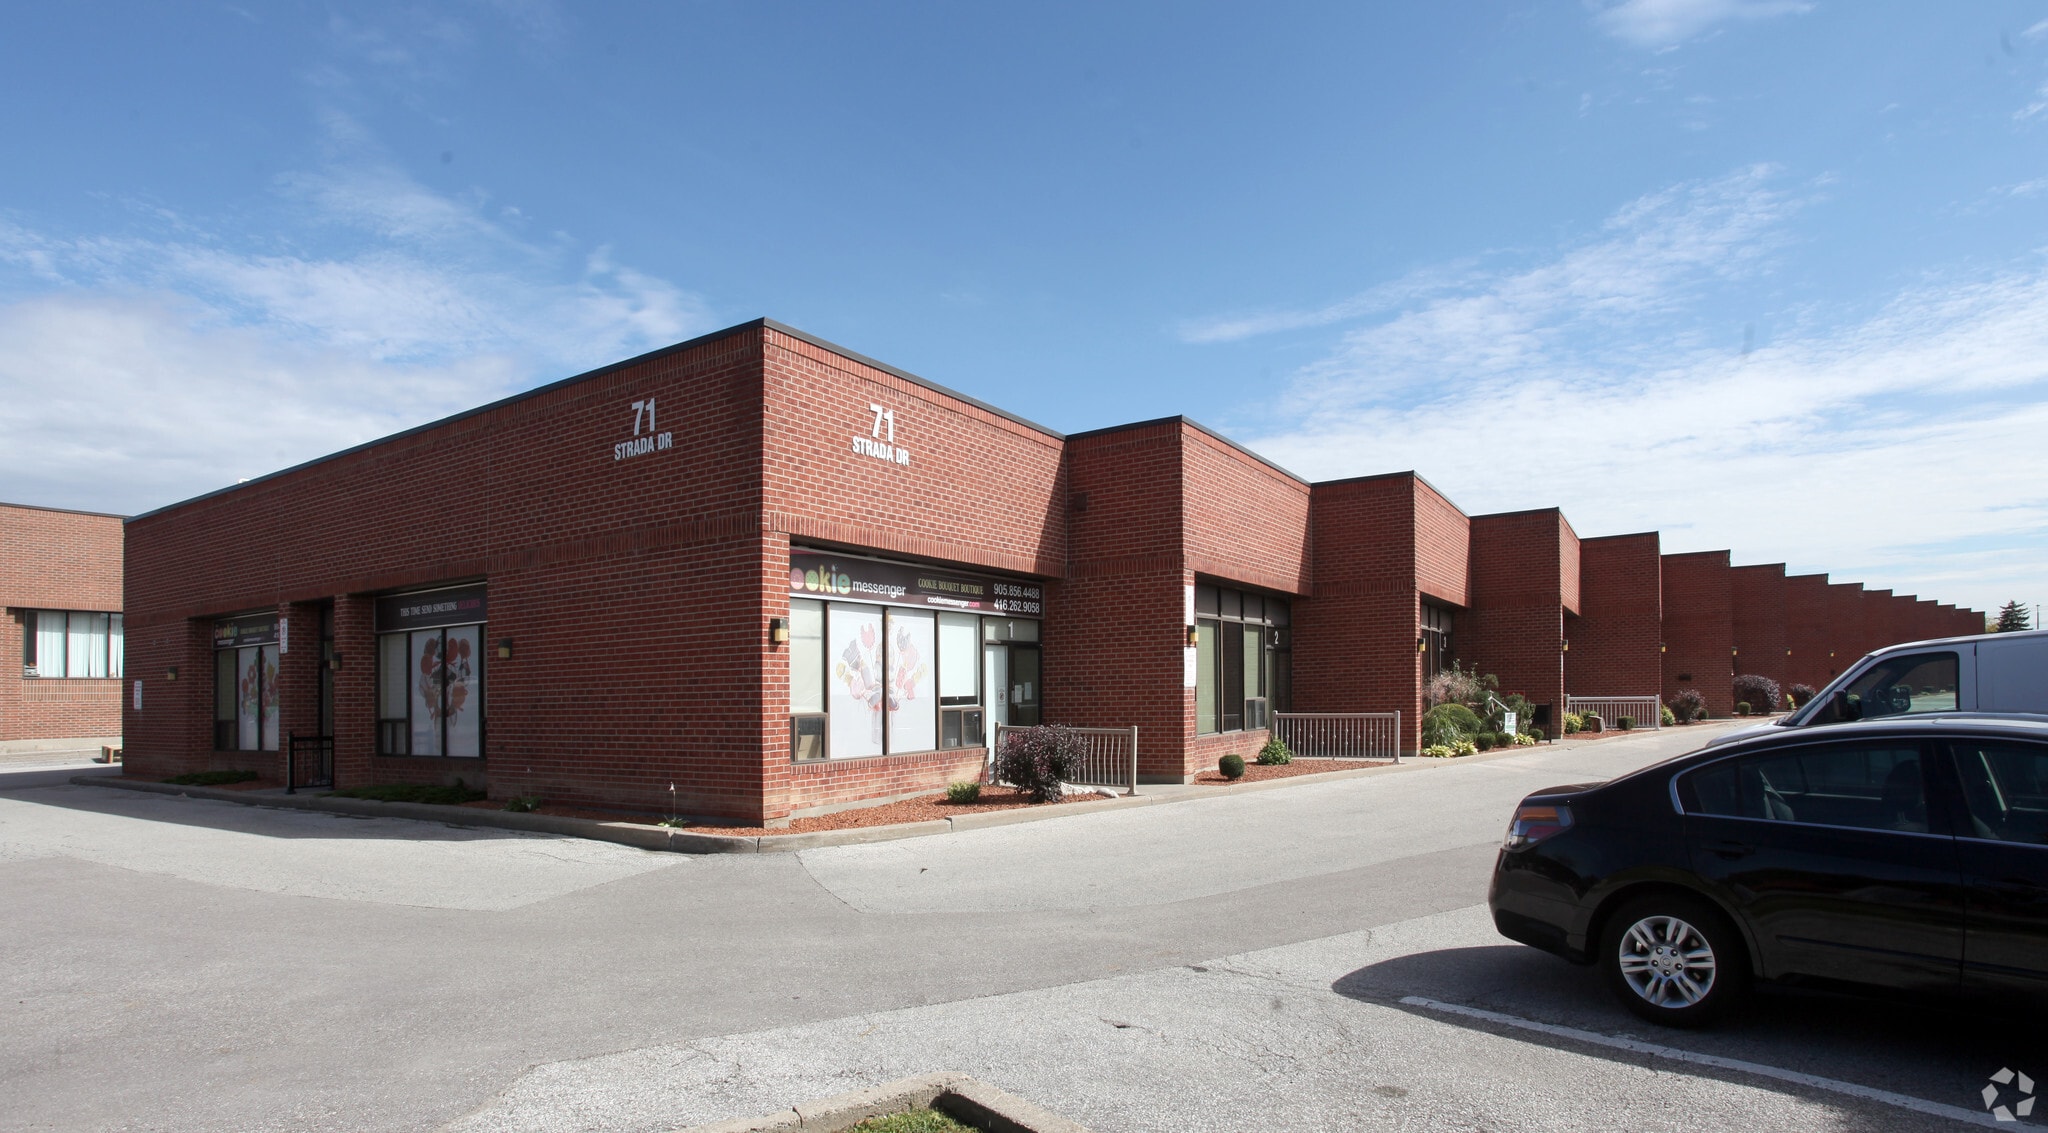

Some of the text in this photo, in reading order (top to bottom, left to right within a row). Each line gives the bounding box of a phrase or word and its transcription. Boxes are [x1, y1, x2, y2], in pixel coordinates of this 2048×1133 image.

[631, 397, 656, 436] 71
[869, 403, 894, 442] 71
[614, 431, 673, 461] STRADA DR
[852, 435, 910, 467] STRADA DR
[790, 564, 907, 599] ookie messenger
[917, 578, 984, 596] COOKIE BOUQUET BOUTIQUE
[993, 583, 1040, 599] 905.856.4488
[993, 598, 1040, 613] 416.262.9058
[1008, 621, 1013, 638] 1
[1274, 630, 1279, 645] 2
